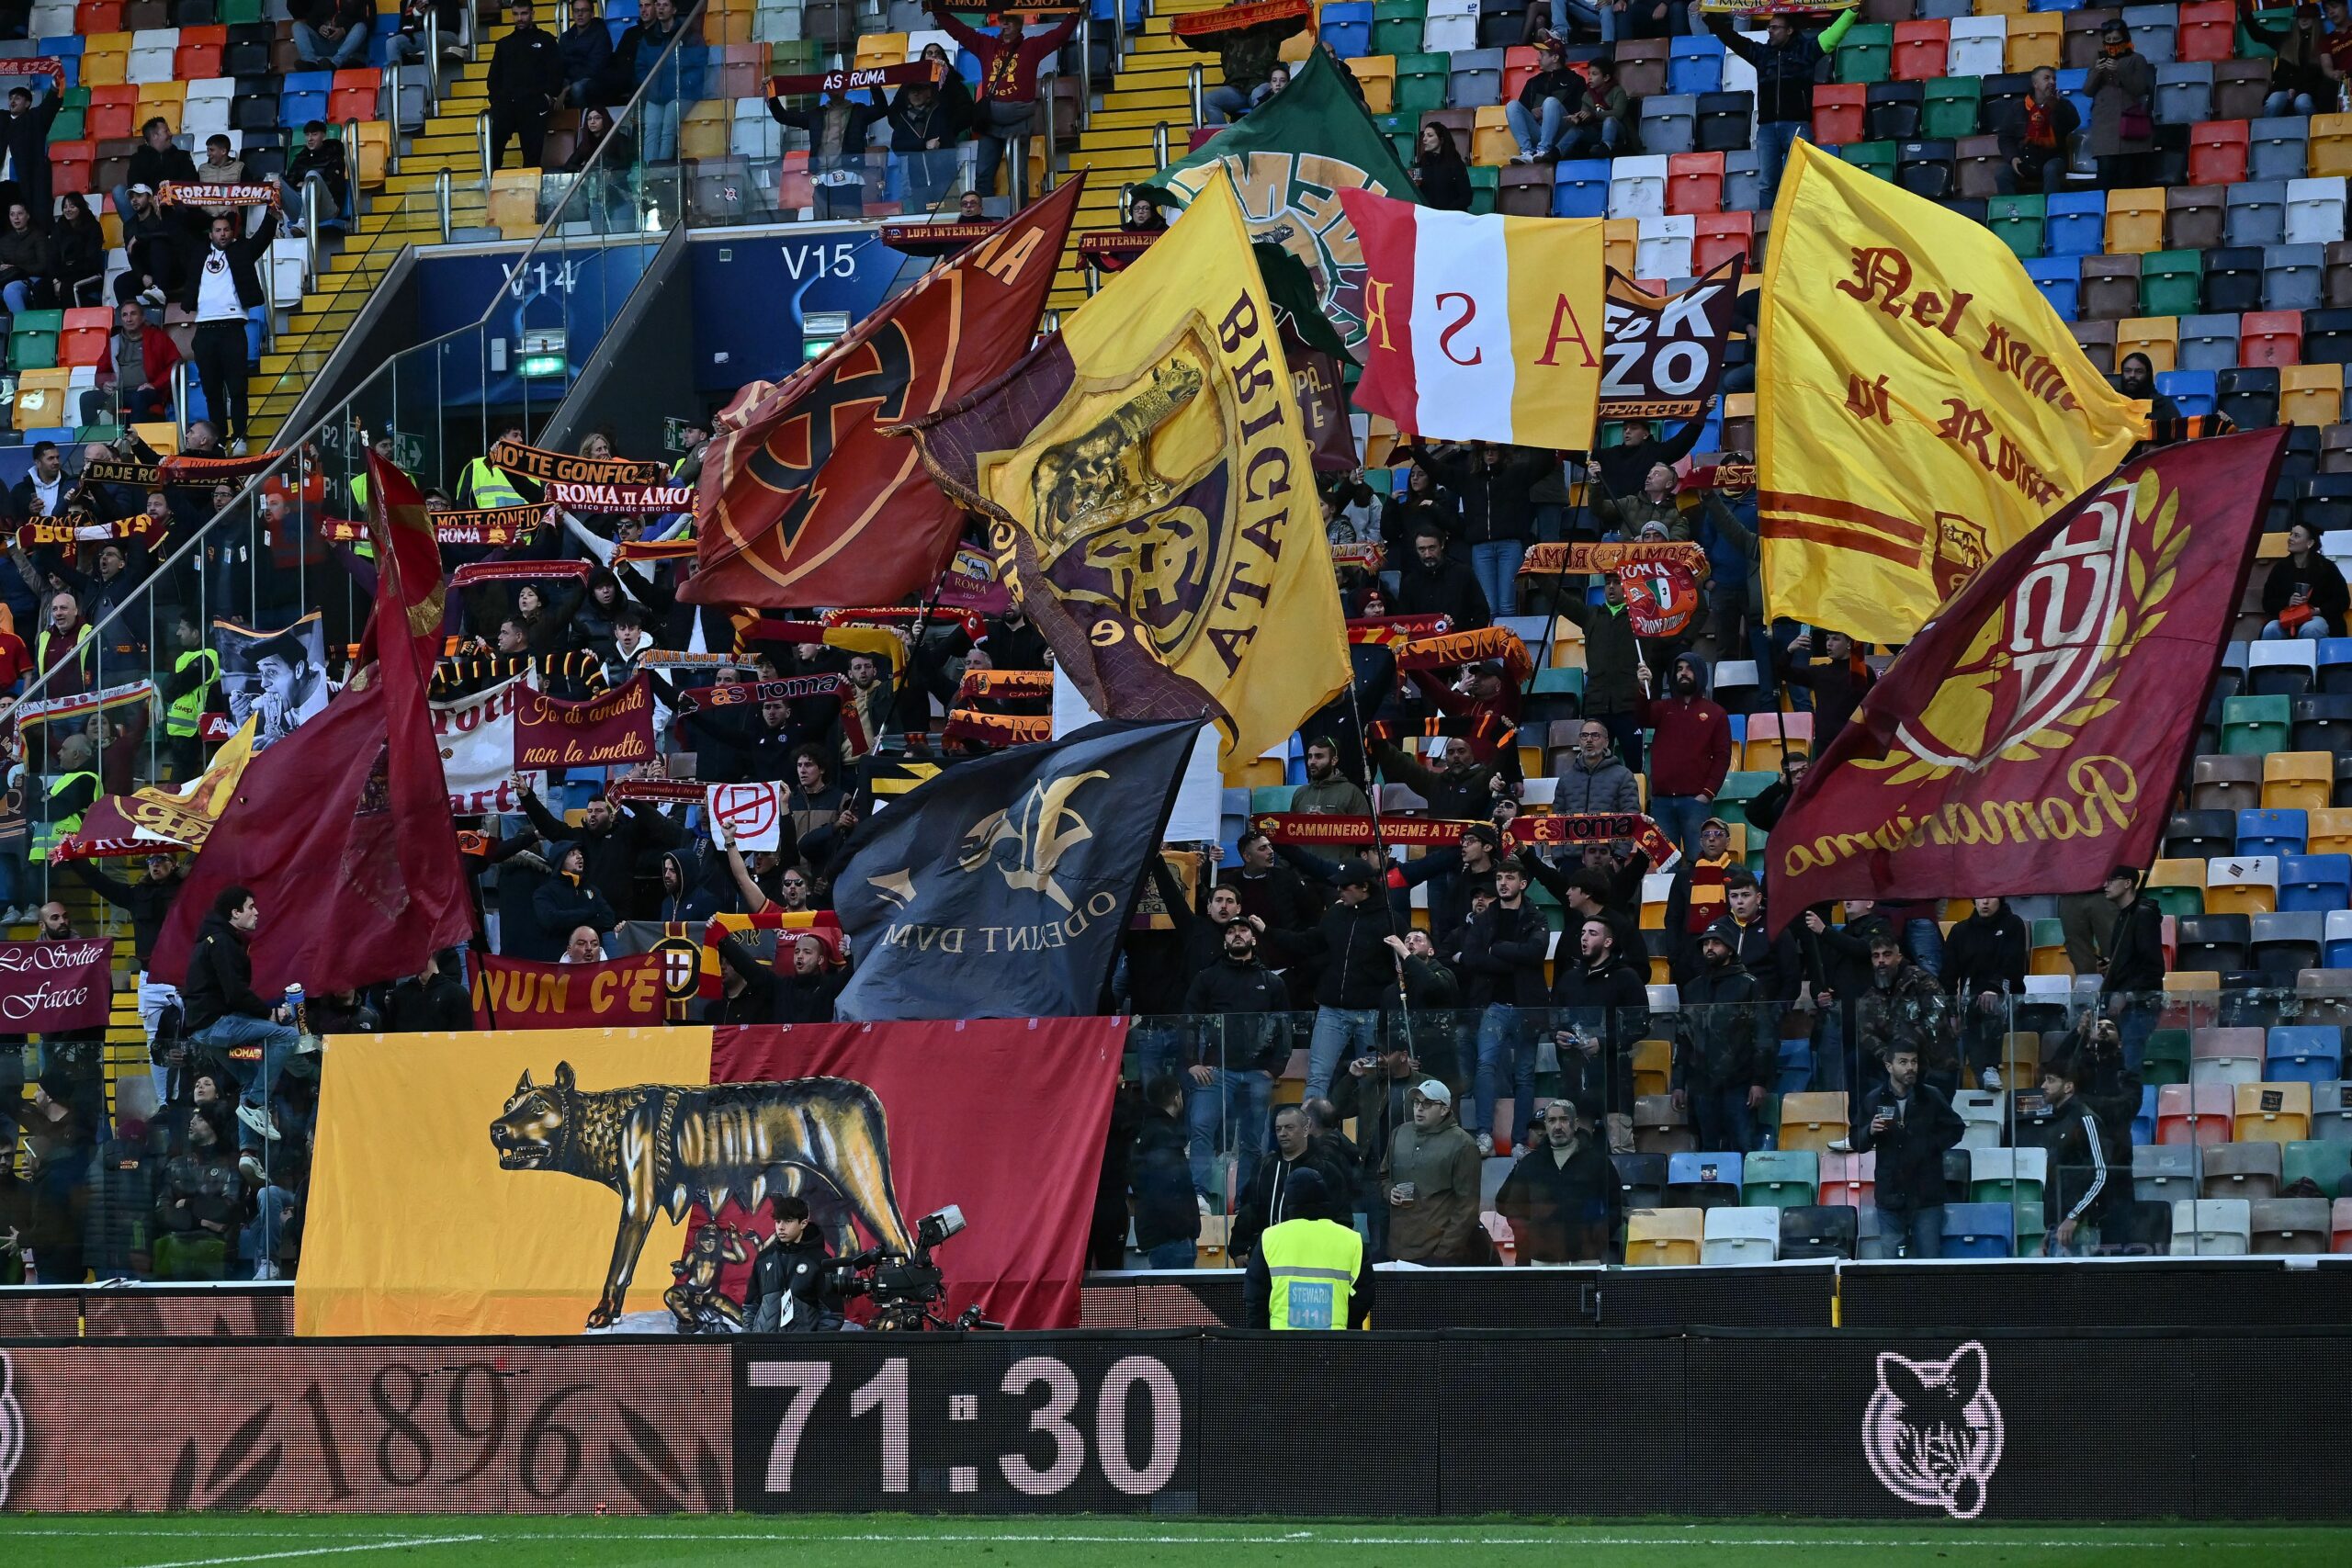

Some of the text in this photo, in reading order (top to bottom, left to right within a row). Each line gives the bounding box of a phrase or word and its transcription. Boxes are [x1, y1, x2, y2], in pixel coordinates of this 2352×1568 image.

[823, 68, 886, 90] AS ROMA
[175, 186, 272, 200] FORZA ROMA
[907, 228, 931, 238] LUPI
[782, 244, 856, 280] V15
[502, 260, 576, 296] V14
[1836, 246, 1973, 338] Nel
[1645, 404, 1694, 416] CREW
[322, 424, 338, 448] P2
[93, 464, 134, 479] DAJE
[526, 452, 553, 477] TE
[557, 466, 639, 485] GONFIO
[1713, 465, 1757, 486] ASR
[322, 476, 338, 500] P1
[554, 483, 690, 505] ROMA TI AMO
[571, 502, 672, 514] unico grande amore
[438, 528, 481, 544] ROMA
[955, 577, 987, 594] ROMA
[645, 649, 682, 663] ROMA
[684, 651, 720, 663] CLUB
[1433, 628, 1512, 663] ROMA
[711, 674, 841, 705] as roma
[565, 705, 583, 725] di
[589, 683, 645, 723] amarti
[522, 730, 648, 763] non la smetto
[1287, 821, 1369, 837] CAMMINERÒ
[1430, 823, 1441, 837] A
[1443, 823, 1463, 837] TE
[34, 942, 105, 970] Solite
[2, 980, 89, 1021] Facce
[473, 969, 571, 1014] NUN
[229, 1048, 255, 1059] ROMA
[1292, 1286, 1329, 1304] STEWARD
[303, 1363, 596, 1501] 1896
[746, 1356, 1183, 1498] 71:30
